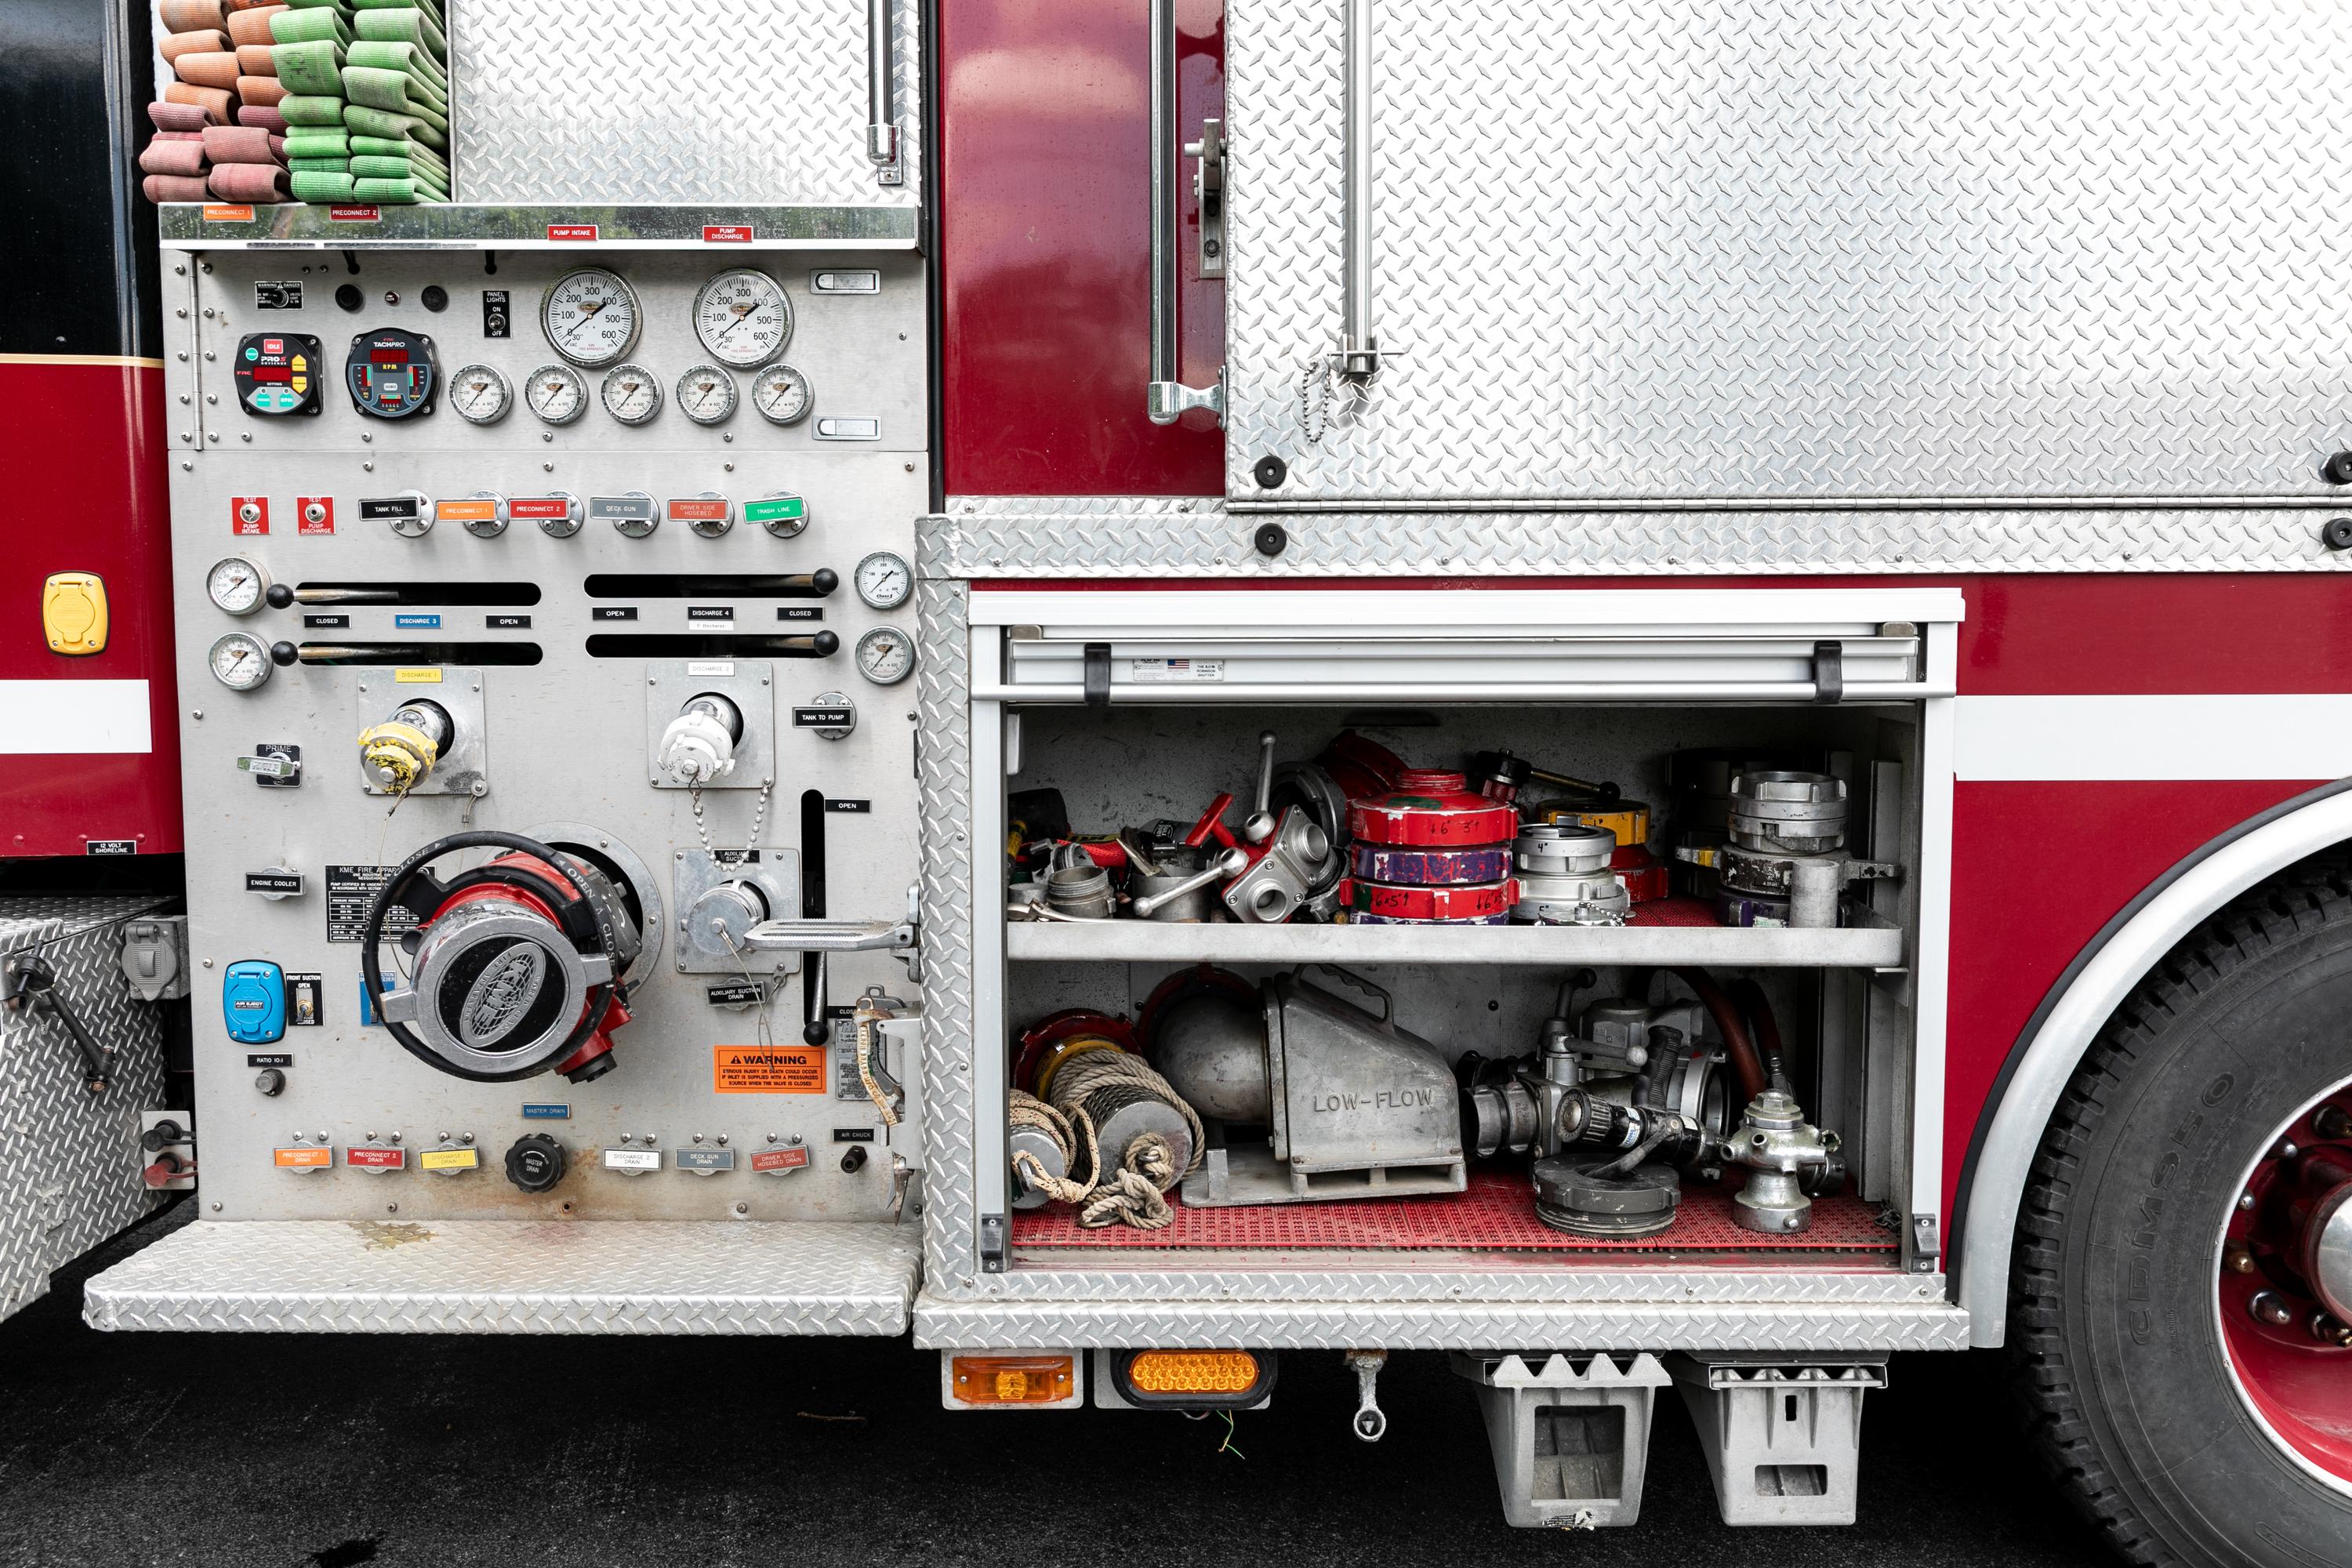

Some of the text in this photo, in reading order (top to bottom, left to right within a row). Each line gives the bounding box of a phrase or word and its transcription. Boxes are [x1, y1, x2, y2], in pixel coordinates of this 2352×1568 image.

[735, 289, 751, 297] 300
[717, 296, 732, 305] 200
[753, 298, 768, 307] 400
[605, 314, 620, 323] 500
[713, 313, 726, 321] 100
[757, 316, 772, 325] 500
[601, 330, 616, 339] 600
[753, 332, 768, 340] 600
[1537, 843, 1548, 853] 4"
[394, 848, 429, 877] CLOSE
[567, 868, 596, 898] OPEN
[602, 923, 616, 967] CLOSE
[464, 974, 491, 1022] APPARATUS
[500, 975, 541, 1033] WORLD CLASS
[743, 1055, 807, 1065] WARNING
[526, 1157, 543, 1167] MASTER
